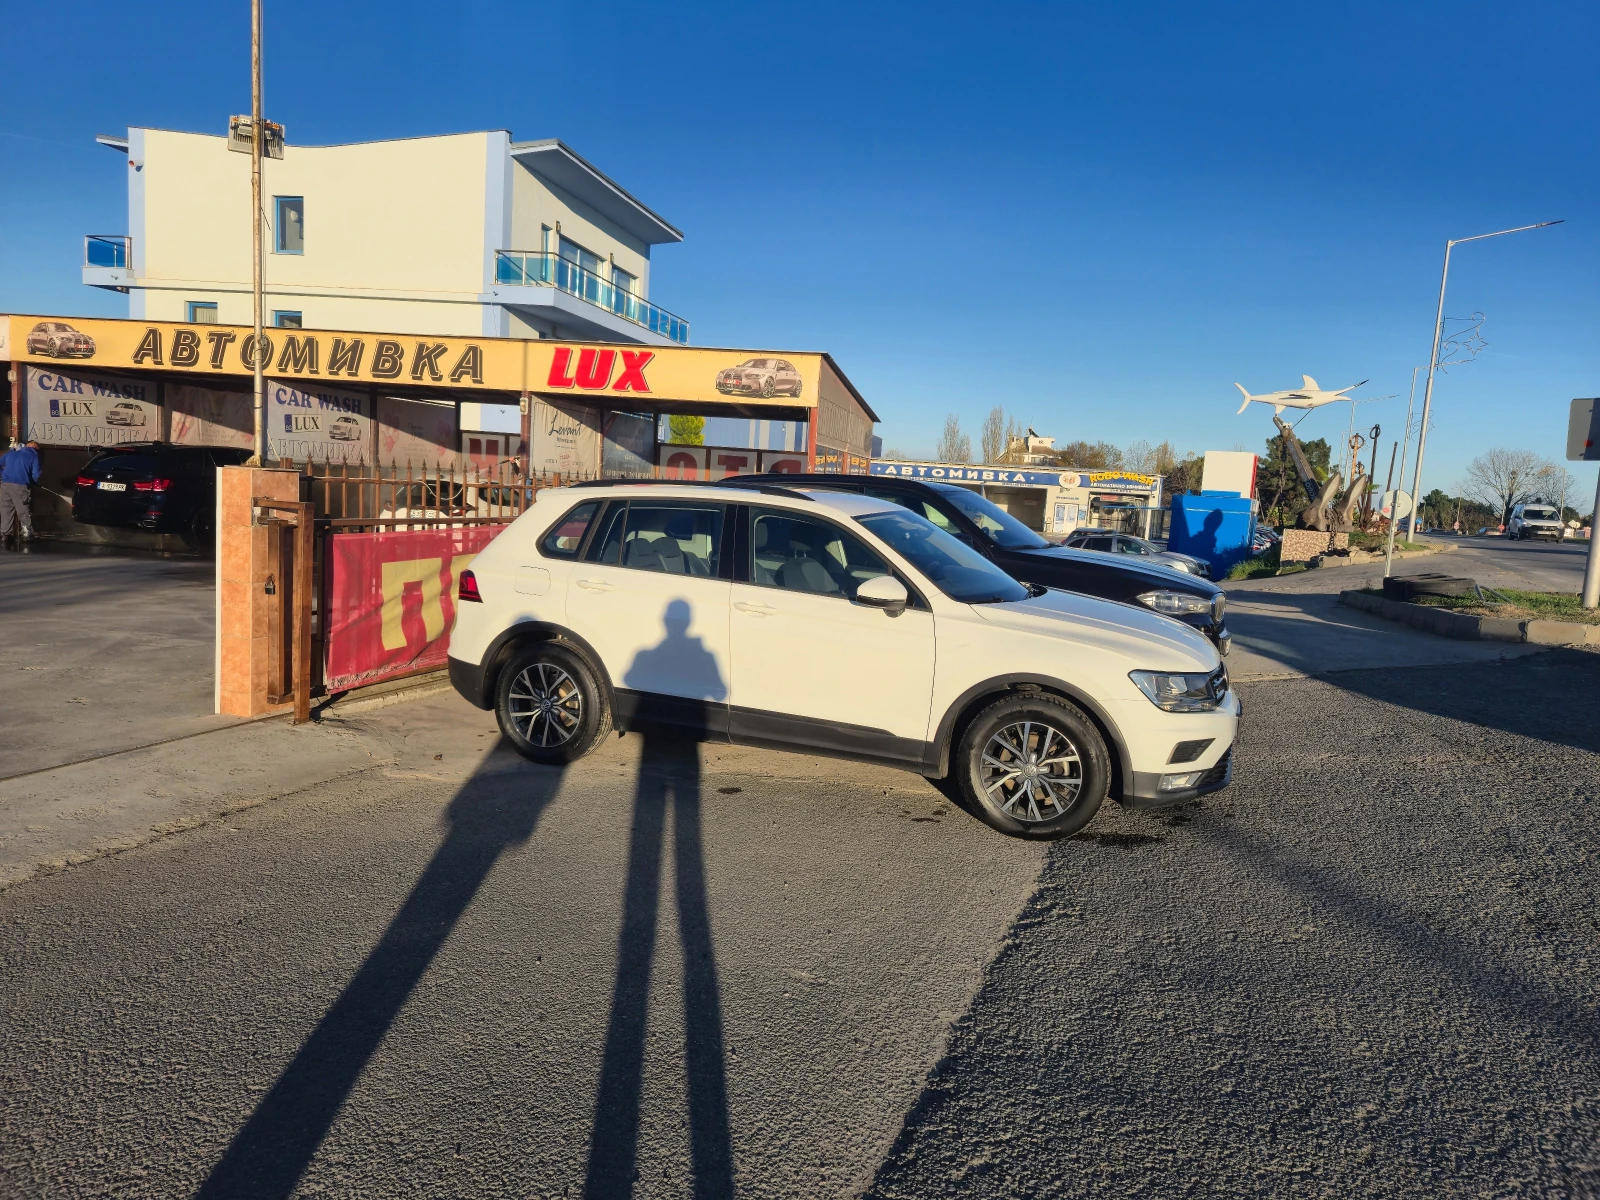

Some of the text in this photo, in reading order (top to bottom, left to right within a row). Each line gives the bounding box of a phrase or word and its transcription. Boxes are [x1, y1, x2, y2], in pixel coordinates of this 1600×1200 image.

[132, 327, 484, 385] АВТОМИВКА
[547, 346, 656, 393] LUX
[38, 374, 146, 401] CAR WASH
[275, 387, 362, 415] CAR WASH
[62, 401, 94, 416] LUX
[294, 416, 320, 431] LUX
[885, 464, 1026, 483] АВТОМИВКА
